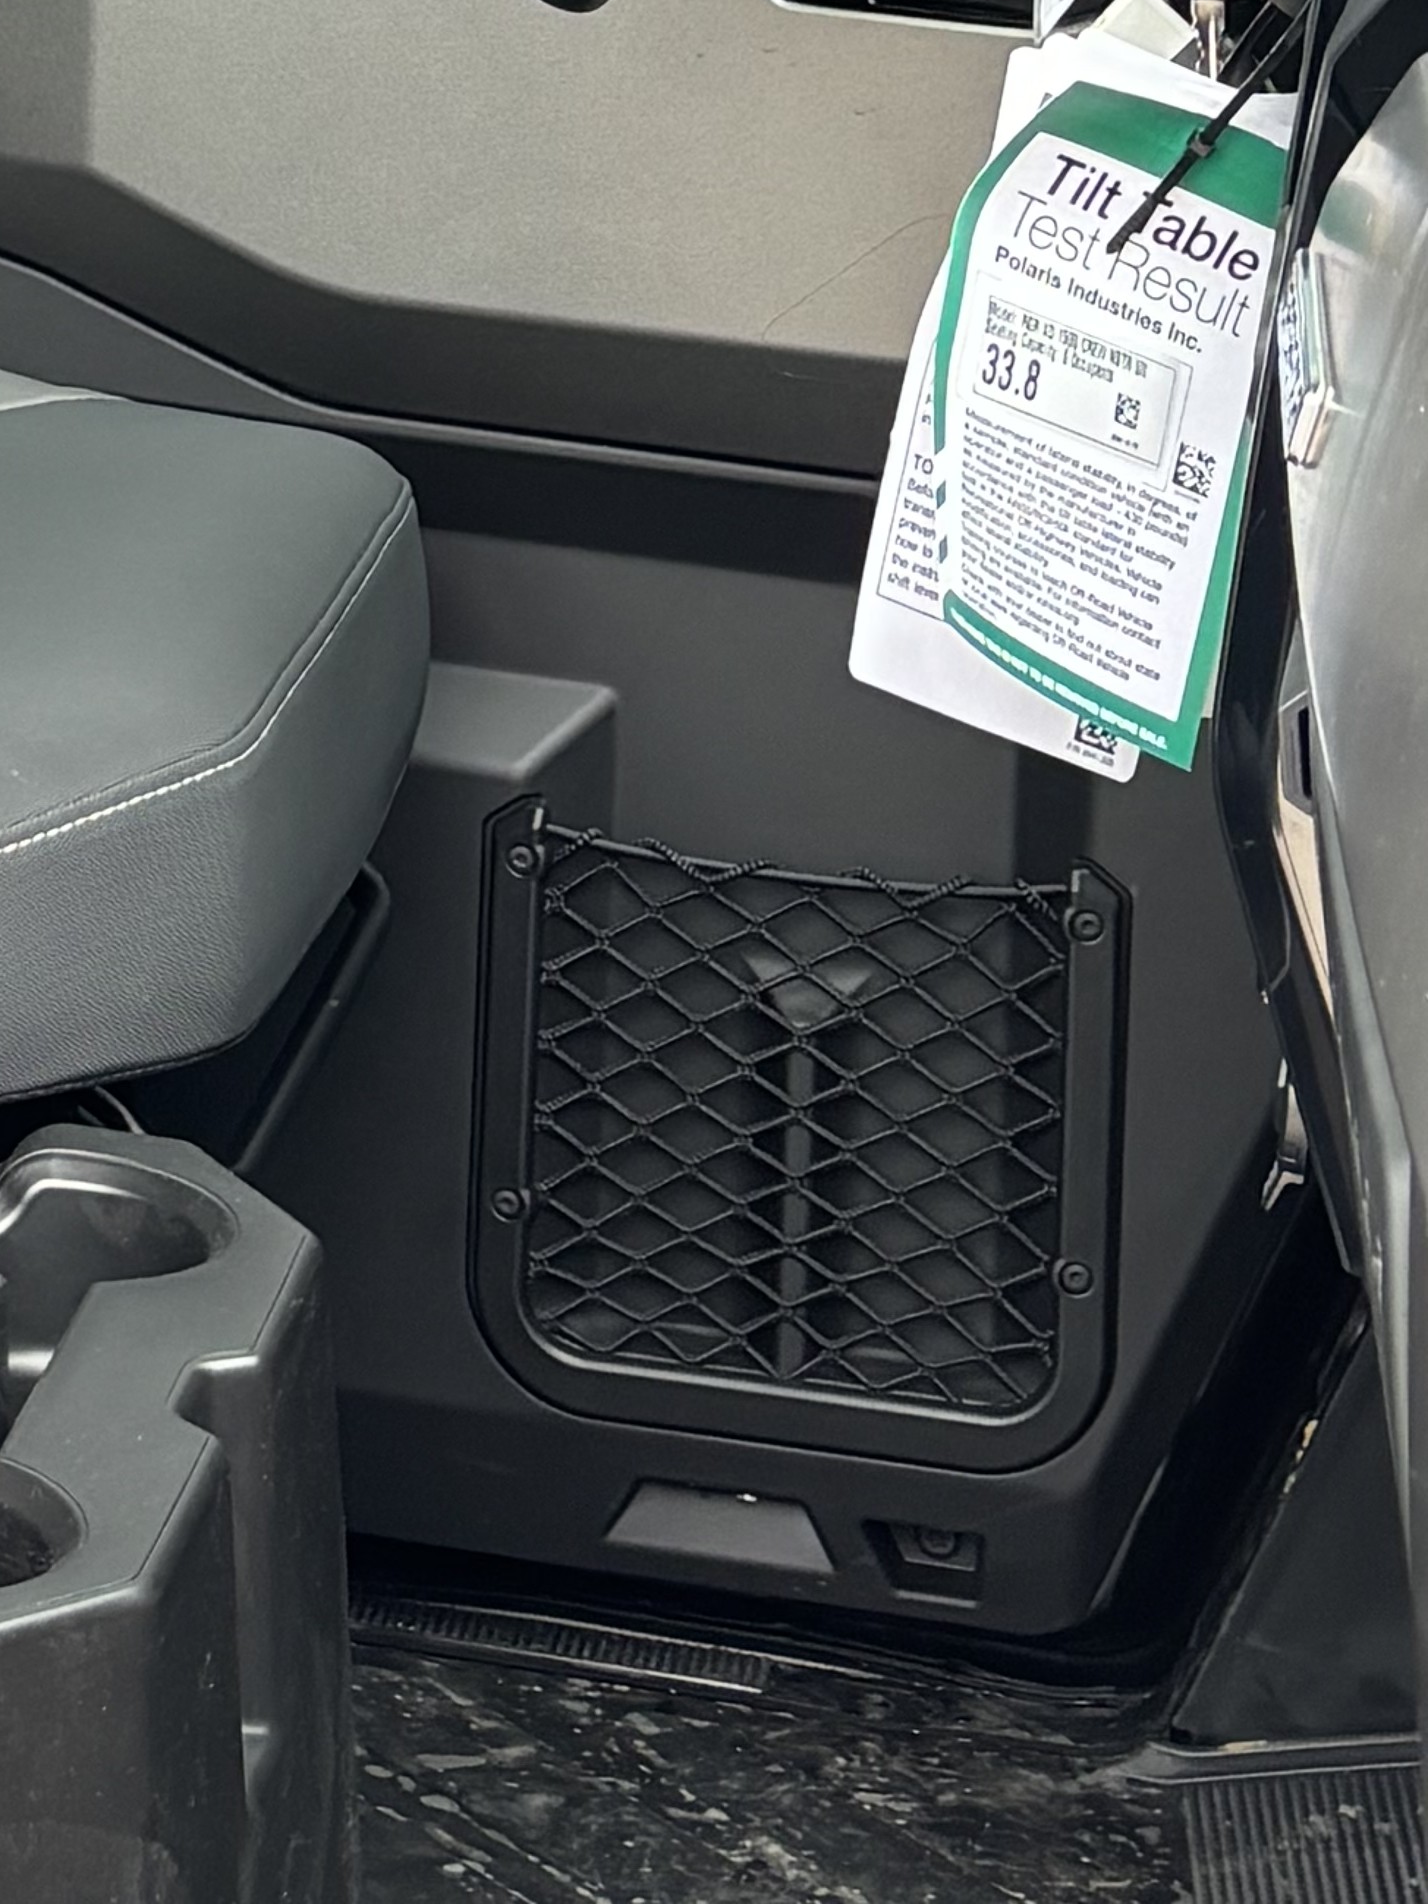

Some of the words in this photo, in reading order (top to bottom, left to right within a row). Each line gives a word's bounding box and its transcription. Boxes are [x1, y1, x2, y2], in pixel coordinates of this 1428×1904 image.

[1047, 154, 1122, 220] Tilt
[994, 245, 1061, 290] Polaris
[1067, 277, 1163, 335] Industries
[1168, 321, 1202, 354] Inc.
[1013, 189, 1101, 271] Test
[1106, 239, 1251, 338] Result
[982, 342, 1041, 402] 33.8
